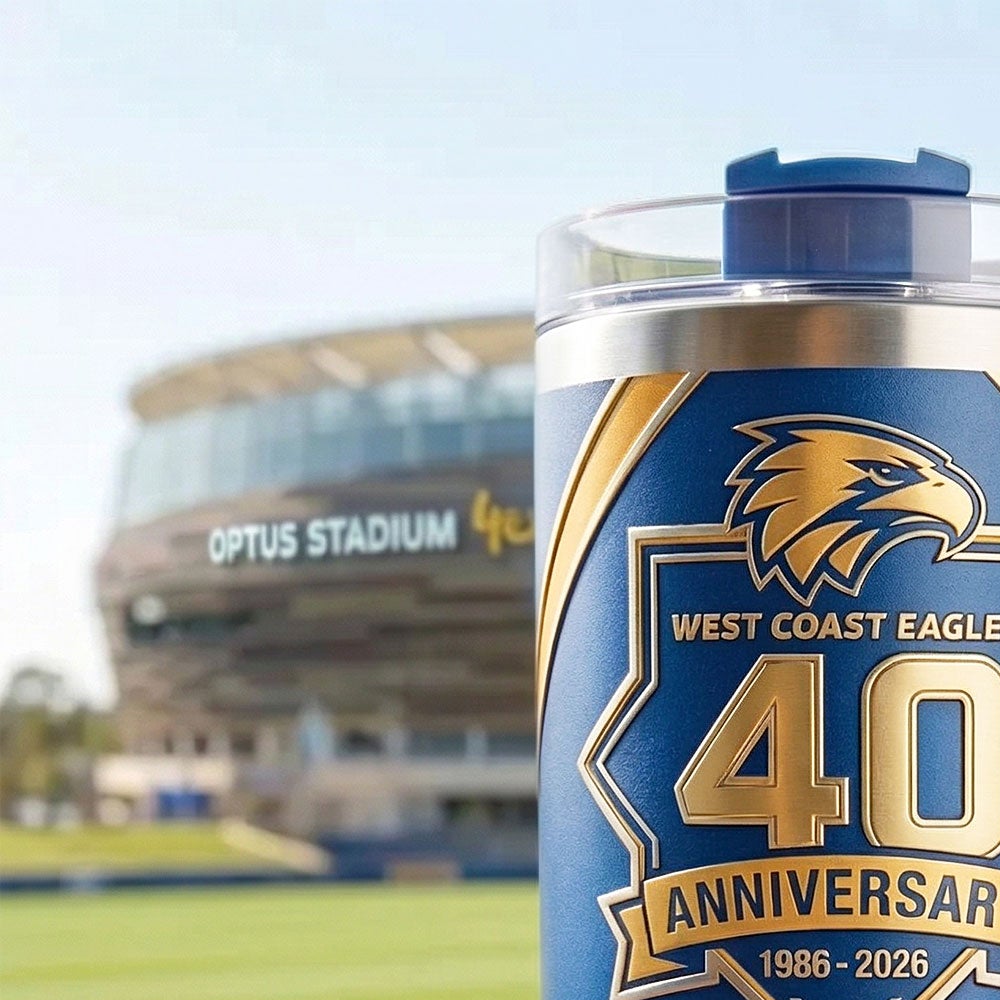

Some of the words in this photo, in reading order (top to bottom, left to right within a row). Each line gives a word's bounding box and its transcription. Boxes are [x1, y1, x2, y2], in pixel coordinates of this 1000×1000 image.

[208, 522, 297, 564] OPTUS
[307, 509, 459, 557] STADIUM
[672, 612, 763, 641] WEST
[771, 612, 888, 641] COAST
[760, 949, 831, 979] 1986
[855, 949, 929, 979] 2026
